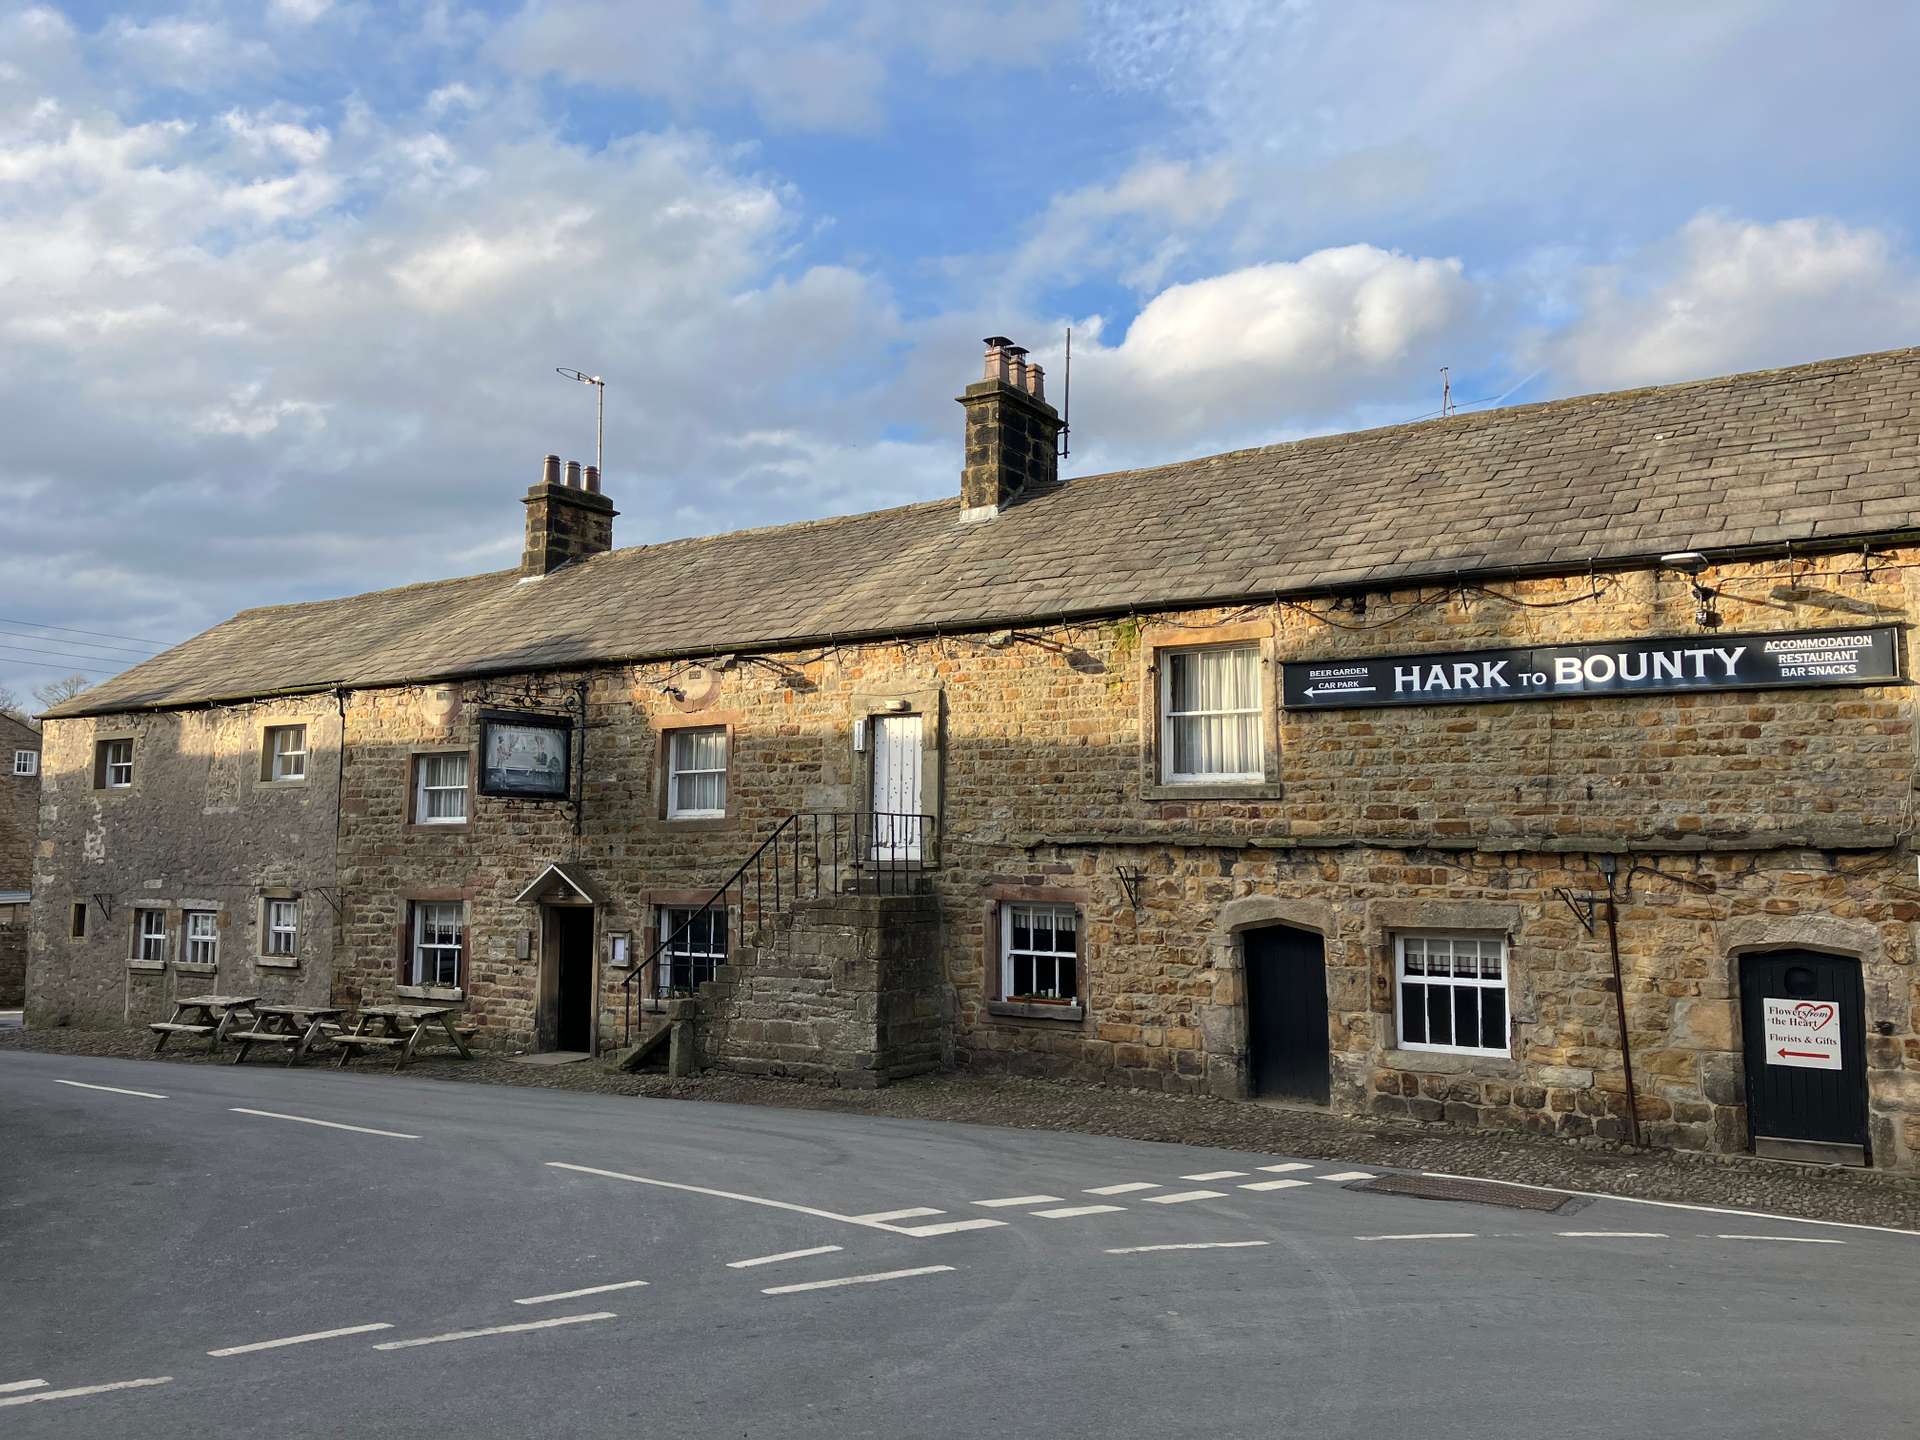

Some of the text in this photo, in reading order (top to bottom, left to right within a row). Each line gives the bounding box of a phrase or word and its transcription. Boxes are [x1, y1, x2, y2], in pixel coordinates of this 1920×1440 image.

[1764, 635, 1872, 651] ACCOMMODATION
[1778, 650, 1859, 664] RESTAURANT
[1310, 667, 1368, 677] BEER GARDEN
[1394, 646, 1748, 693] HARK TO BOUNTY
[1781, 664, 1857, 677] BAR SNACKS
[1337, 680, 1360, 688] PARK
[1769, 1006, 1828, 1018] Flowers from
[1771, 1017, 1818, 1027] the Heart
[1769, 1033, 1838, 1046] Florists & Gifts
